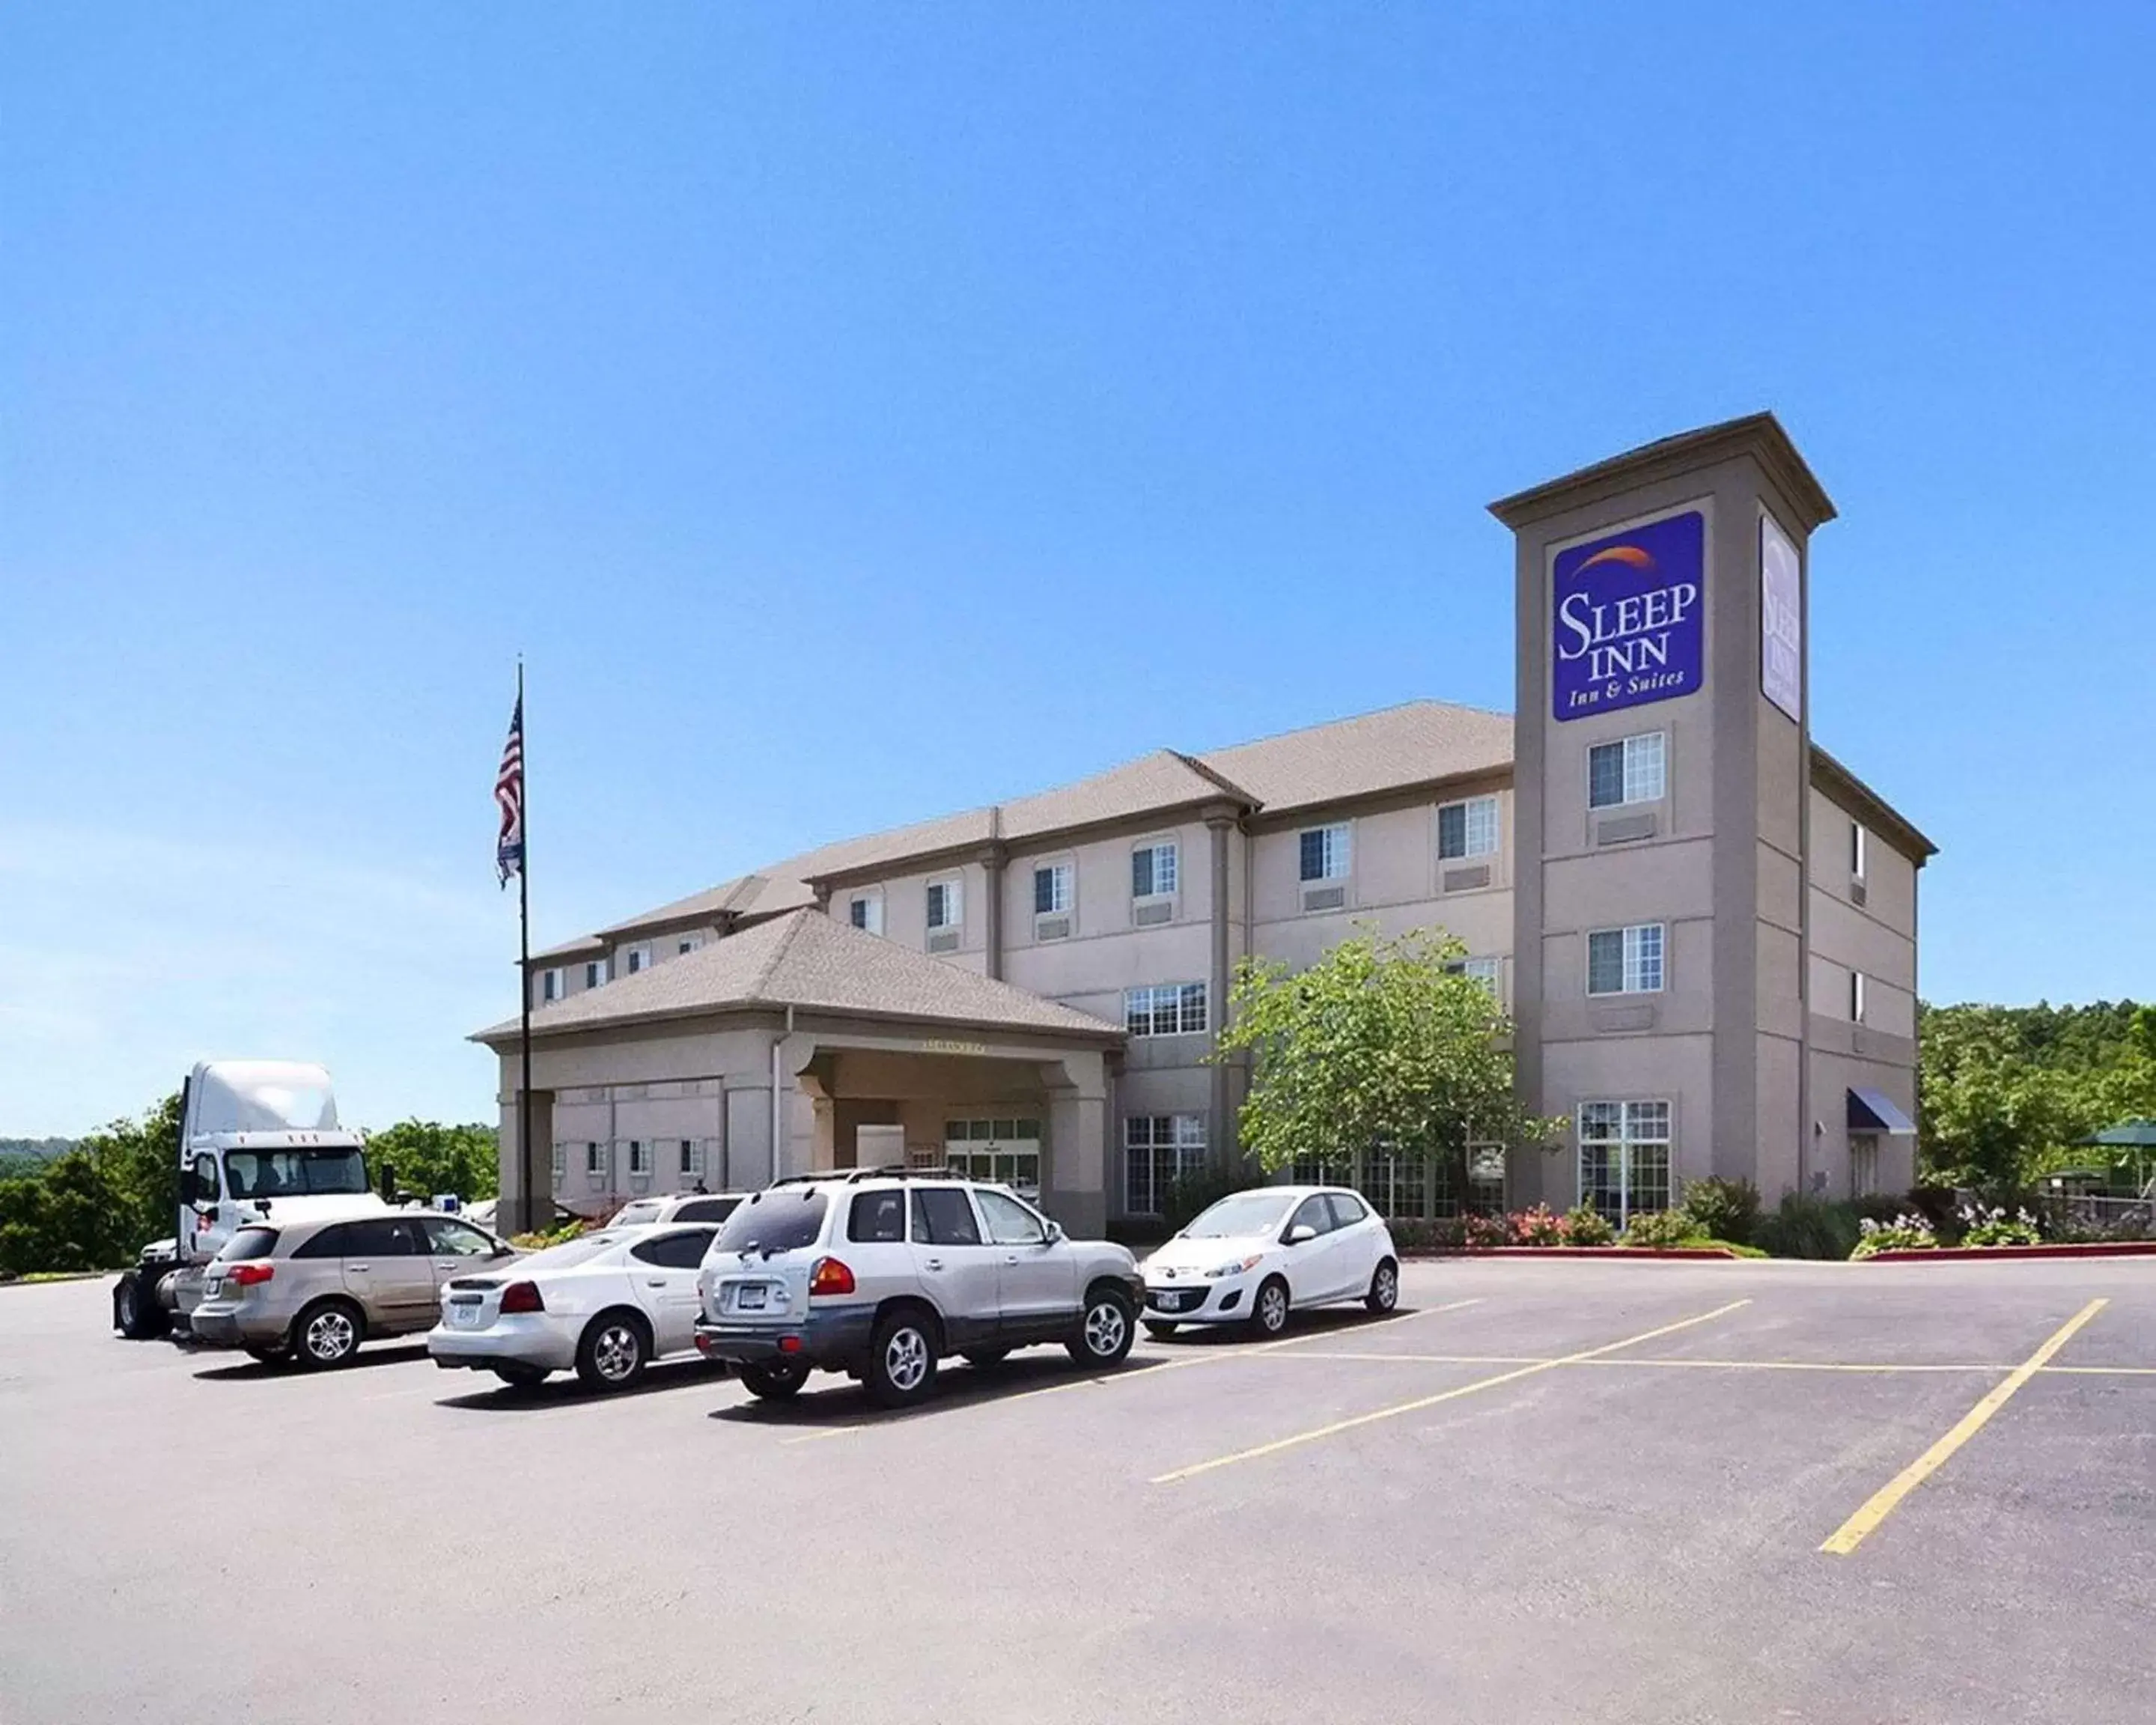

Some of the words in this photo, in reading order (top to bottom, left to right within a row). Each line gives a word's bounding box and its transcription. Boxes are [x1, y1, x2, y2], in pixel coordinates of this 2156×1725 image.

[1559, 584, 1696, 660] SLEEP
[1589, 633, 1670, 681] INN
[1570, 690, 1599, 706] Inn
[1607, 681, 1621, 697] &
[1627, 671, 1684, 695] Suites
